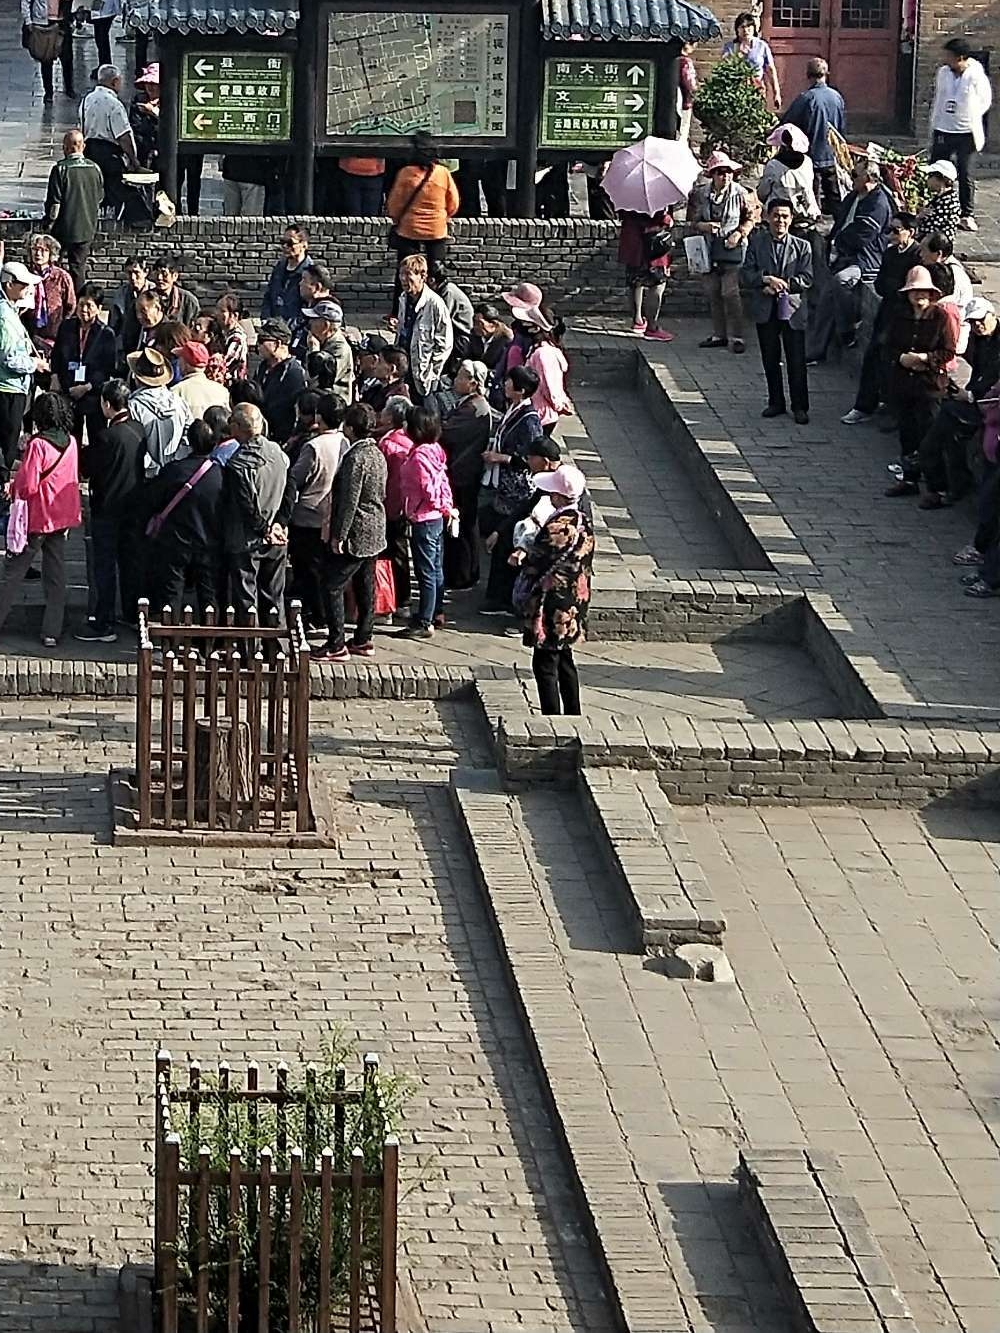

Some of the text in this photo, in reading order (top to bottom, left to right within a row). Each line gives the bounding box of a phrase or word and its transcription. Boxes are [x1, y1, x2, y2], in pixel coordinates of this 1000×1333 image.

[556, 62, 619, 74] 南大街
[218, 112, 280, 124] 上西门
